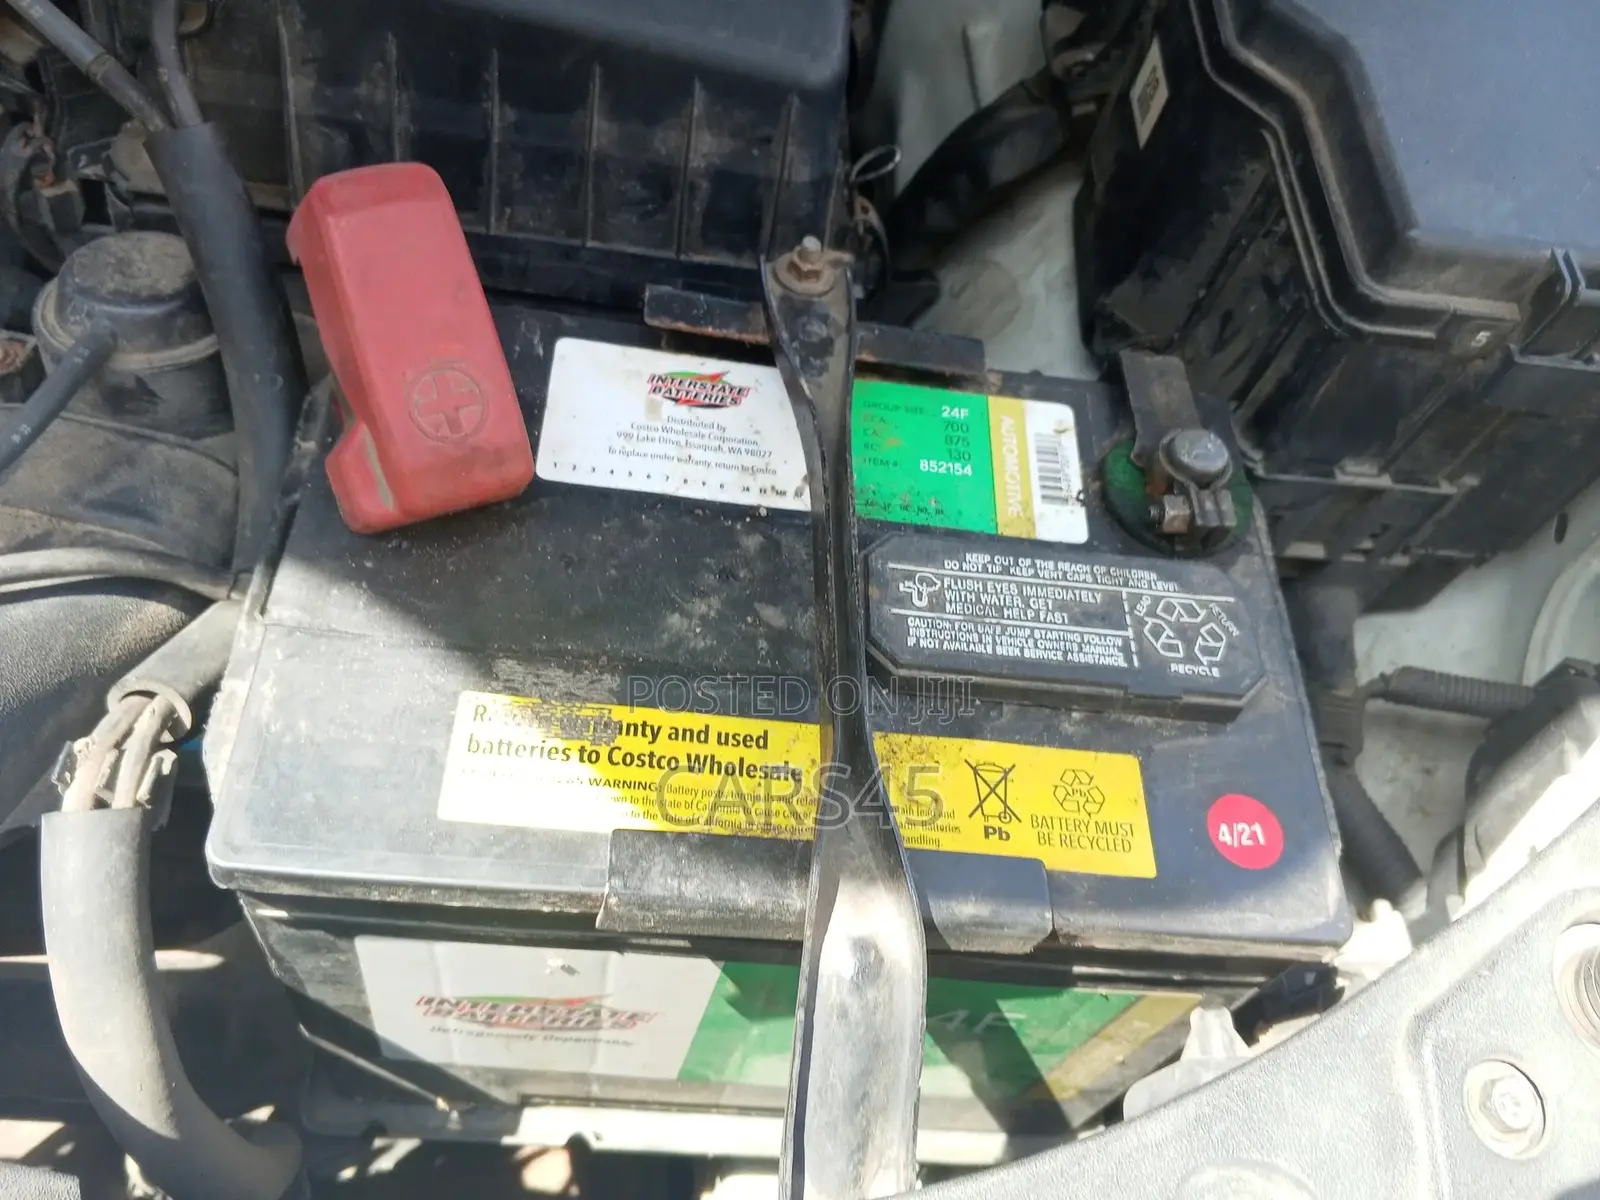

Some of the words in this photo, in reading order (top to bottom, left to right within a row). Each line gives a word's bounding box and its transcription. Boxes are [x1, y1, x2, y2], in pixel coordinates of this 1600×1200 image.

[648, 373, 750, 397] INTERSTATE
[649, 385, 742, 406] BATTERIES
[941, 404, 970, 420] 24F
[631, 422, 659, 433] Costco
[661, 425, 706, 440] Wholesale
[667, 415, 715, 430] Distributed
[717, 421, 727, 433] by
[944, 421, 970, 434] 700
[617, 430, 634, 440] 999
[636, 433, 656, 443] Lake
[728, 446, 743, 456] WA
[744, 448, 772, 459] 98027
[948, 448, 972, 462] 130
[608, 445, 616, 454] To
[619, 448, 648, 459] replace
[650, 452, 675, 461] under
[715, 461, 739, 471] return
[741, 463, 750, 473] to
[751, 464, 777, 476] Costco
[919, 458, 973, 477] 852154
[1001, 415, 1025, 520] AUTOMOTIVE
[944, 559, 959, 571] DO
[963, 561, 983, 573] NOT
[1010, 566, 1035, 578] KEEP
[1038, 568, 1063, 581] VENT
[1066, 572, 1093, 584] CAPS
[1096, 574, 1125, 587] TIGHT
[1128, 578, 1148, 590] AND
[966, 552, 991, 565] KEEP
[994, 554, 1014, 566] OUT
[1018, 556, 1032, 568] OF
[1035, 558, 1055, 571] THE
[1058, 561, 1090, 574] REACH
[1093, 564, 1106, 576] OF
[943, 577, 983, 593] FLUSH
[987, 581, 1018, 596] EYES
[1022, 584, 1102, 605] IMMEDIATELY
[944, 588, 976, 604] WITH
[1029, 597, 1053, 611] GET
[945, 601, 999, 618] MEDICAL
[1003, 606, 1035, 621] HELP
[1039, 610, 1069, 625] FAST
[909, 627, 979, 643] INSTRUCTIONS
[982, 632, 993, 645] IN
[995, 634, 1034, 649] VEHICLE
[1037, 639, 1079, 653] OWNERS
[955, 620, 975, 633] FOR
[978, 623, 1002, 635] SAFE
[1005, 626, 1031, 639] JUMP
[1034, 629, 1081, 643] STARTING
[1083, 633, 1122, 647] FOLLOW
[907, 636, 917, 647] IF
[920, 638, 940, 650] NOT
[942, 640, 993, 655] AVAILABLE
[996, 645, 1021, 657] SEEK
[1023, 648, 1064, 661] SERVICE
[1169, 662, 1220, 678] RECYCLE
[667, 723, 711, 744] and
[716, 729, 769, 750] used
[467, 733, 572, 763] batteries
[578, 744, 601, 765] to
[606, 746, 680, 772] Costco
[686, 752, 803, 783] Wholesale
[666, 783, 700, 797] Battery
[1071, 787, 1087, 799] Pb
[630, 794, 640, 805] to
[641, 795, 657, 807] the
[660, 797, 682, 809] state
[684, 799, 694, 811] of
[696, 801, 741, 815] California
[754, 807, 782, 817] cause
[642, 810, 659, 821] the
[685, 814, 695, 825] of
[697, 816, 742, 829] California
[921, 820, 961, 834] Batteries
[1031, 813, 1092, 834] BATTERY
[1094, 820, 1134, 838] MUST
[983, 825, 1011, 842] Pb
[1037, 830, 1055, 847] BE
[1059, 832, 1132, 853] RECYCLED
[1218, 820, 1267, 849] 4/21
